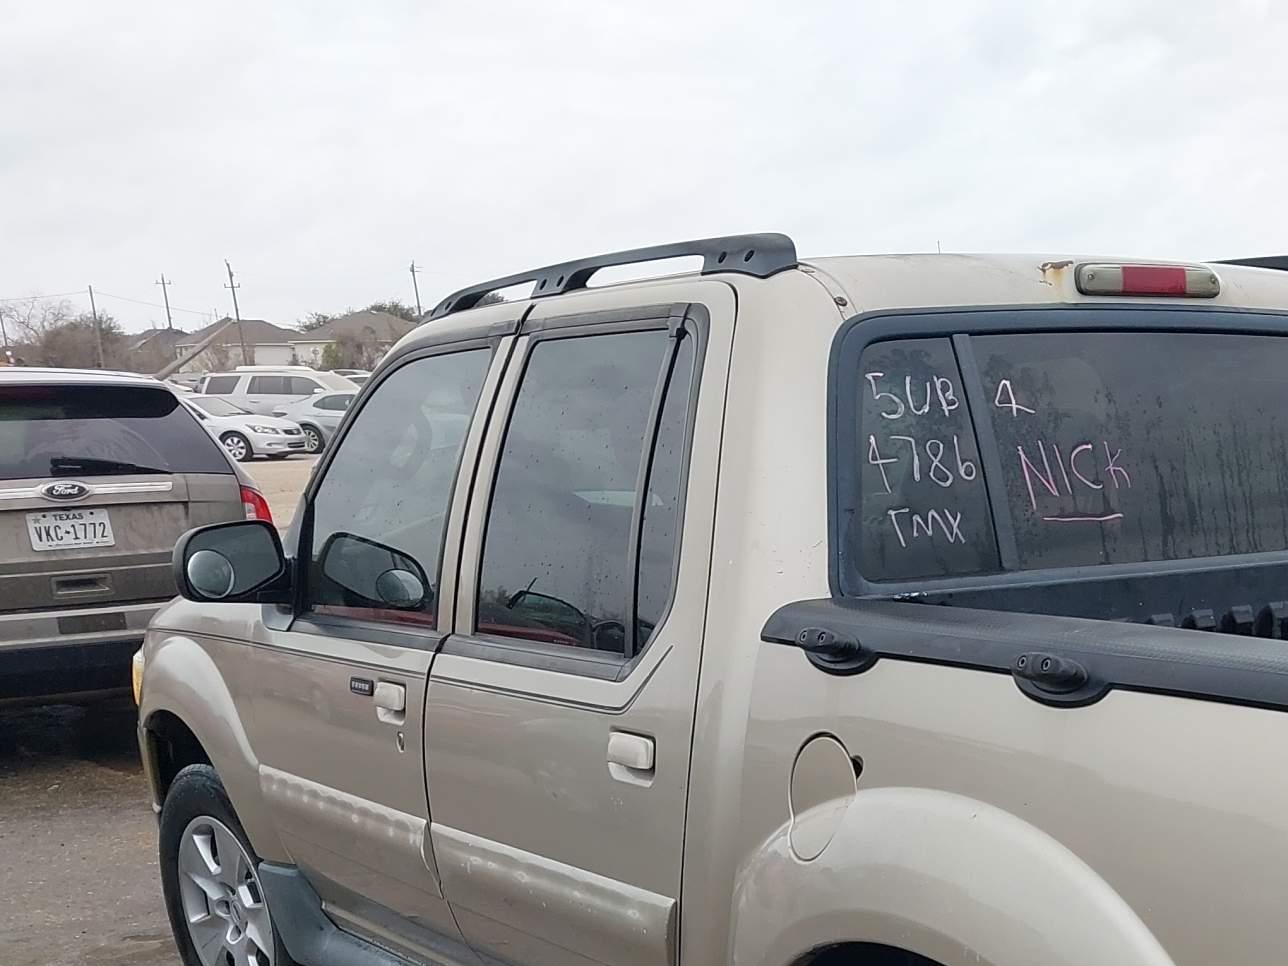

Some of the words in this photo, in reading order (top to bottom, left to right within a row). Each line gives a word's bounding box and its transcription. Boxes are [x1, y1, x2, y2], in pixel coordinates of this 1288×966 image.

[868, 434, 976, 494] 4786
[1017, 440, 1132, 511] NICK
[52, 483, 80, 495] Ford
[52, 512, 84, 521] TEXAS
